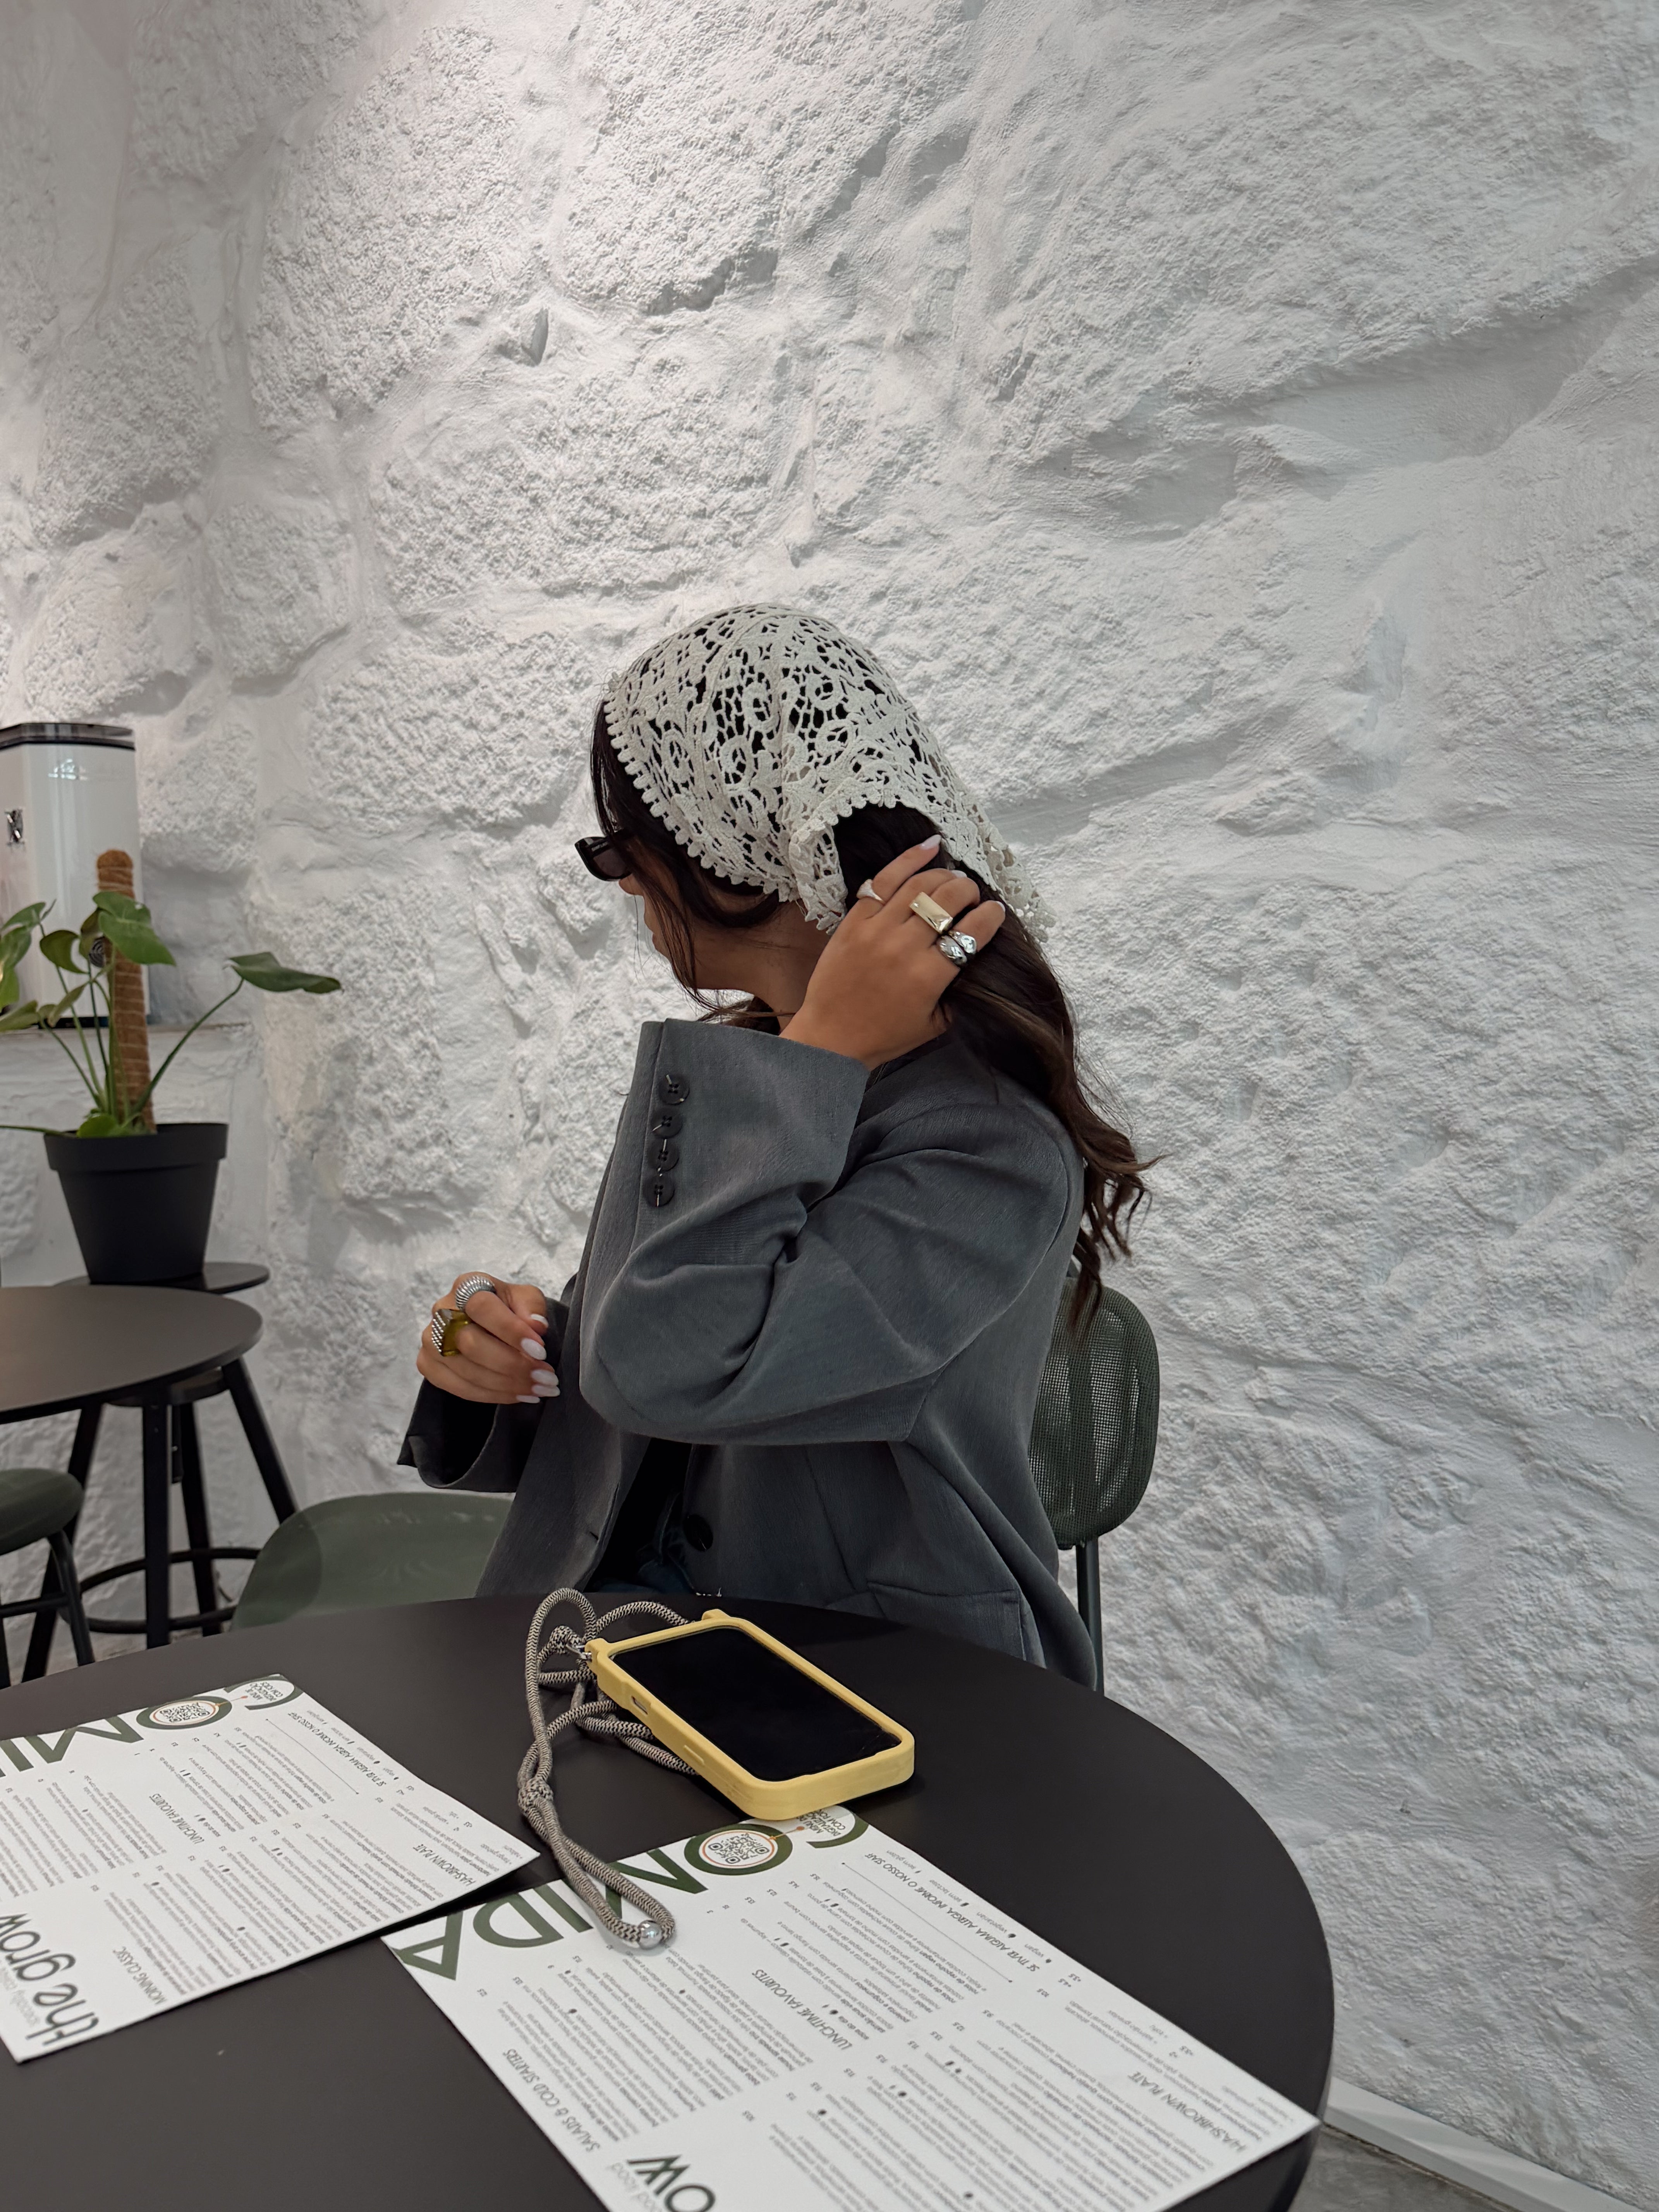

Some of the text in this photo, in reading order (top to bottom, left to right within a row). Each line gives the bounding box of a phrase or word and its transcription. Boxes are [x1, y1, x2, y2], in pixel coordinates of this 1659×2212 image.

[0, 1674, 304, 1778] COMI
[298, 1719, 314, 1730] NOSSO
[315, 1732, 336, 1745] INFORME
[349, 1757, 371, 1772] ALGUMA
[366, 1772, 381, 1782] TIVER
[149, 1794, 204, 1844] LUNCHTIME FAVOURITES
[829, 1818, 846, 1830] COM
[413, 1844, 475, 1886] HASHBROWN PLATE
[865, 1853, 886, 1865] STAFF
[903, 1860, 916, 1870] sem
[883, 1863, 910, 1882] NOSSO
[823, 1882, 848, 1899] cogumelos
[915, 1887, 947, 1908] INFORME
[929, 1880, 962, 1902] sem lactose
[784, 1901, 800, 1913] beurre
[847, 1899, 860, 1908] com
[866, 1904, 882, 1916] molho
[799, 1912, 811, 1921] com
[827, 1908, 842, 1919] carne
[858, 1906, 883, 1925] recheadas
[881, 1915, 894, 1924] com
[809, 1920, 827, 1934] servido
[840, 1918, 852, 1927] com
[882, 1924, 898, 1935] couve
[977, 1912, 1007, 1933] vegetarian
[747, 1923, 767, 1939] legumes
[851, 1926, 876, 1944] recheadas
[861, 1925, 878, 1937] molho
[892, 1923, 914, 1938] servidas
[793, 1934, 809, 1947] frango
[826, 1933, 851, 1951] espinafres
[848, 1940, 865, 1952] raspas
[877, 1936, 890, 1945] com
[904, 1940, 920, 1952] folhas
[976, 1929, 1010, 1950] ALGUMA
[0, 1915, 74, 1980] grow
[808, 1946, 821, 1955] com
[875, 1944, 891, 1955] couve
[888, 1944, 910, 1960] servidas
[917, 1941, 946, 1962] lentamente
[1024, 1944, 1044, 1958] vegan
[819, 1954, 838, 1968] servida
[854, 1953, 870, 1966] ricotta
[870, 1957, 887, 1970] toque
[919, 1951, 936, 1963] vegan
[1007, 1951, 1029, 1965] TIVER
[788, 1957, 812, 1976] ratatouille
[812, 1966, 826, 1977] base
[897, 1960, 914, 1973] folhas
[936, 1963, 957, 1978] repolho
[945, 1961, 967, 1977] cozidas
[1026, 1964, 1040, 1972] SE
[113, 1947, 166, 2004] MORNING CLASSIC
[811, 1975, 824, 1985] com
[836, 1967, 857, 1982] polenta
[875, 1971, 901, 1989] artesanal
[913, 1963, 944, 1985] lentamente
[913, 1972, 934, 1987] repolho
[899, 1978, 912, 1988] alho
[963, 1984, 979, 1994] rolos
[822, 1984, 842, 1999] servido
[828, 1979, 858, 2002] lentamente
[855, 1982, 884, 2004] cogumelos
[899, 1989, 916, 2001] ravioli
[941, 1992, 956, 2003] rolos
[943, 1984, 964, 2000] cozidas
[887, 1997, 917, 2019] cogumelos
[914, 2000, 933, 2013] ravioli
[918, 1993, 941, 2009] noisette
[29, 1984, 98, 2044] the
[752, 1970, 852, 2049] LUNCHTIME FAVOURITES
[888, 2007, 910, 2023] polenta
[864, 2018, 885, 2033] salmão
[855, 2029, 869, 2040] sopa
[503, 2049, 600, 2152] SALADS & COLD STARTERS
[1128, 2072, 1245, 2151] HASHBROWN PLATE
